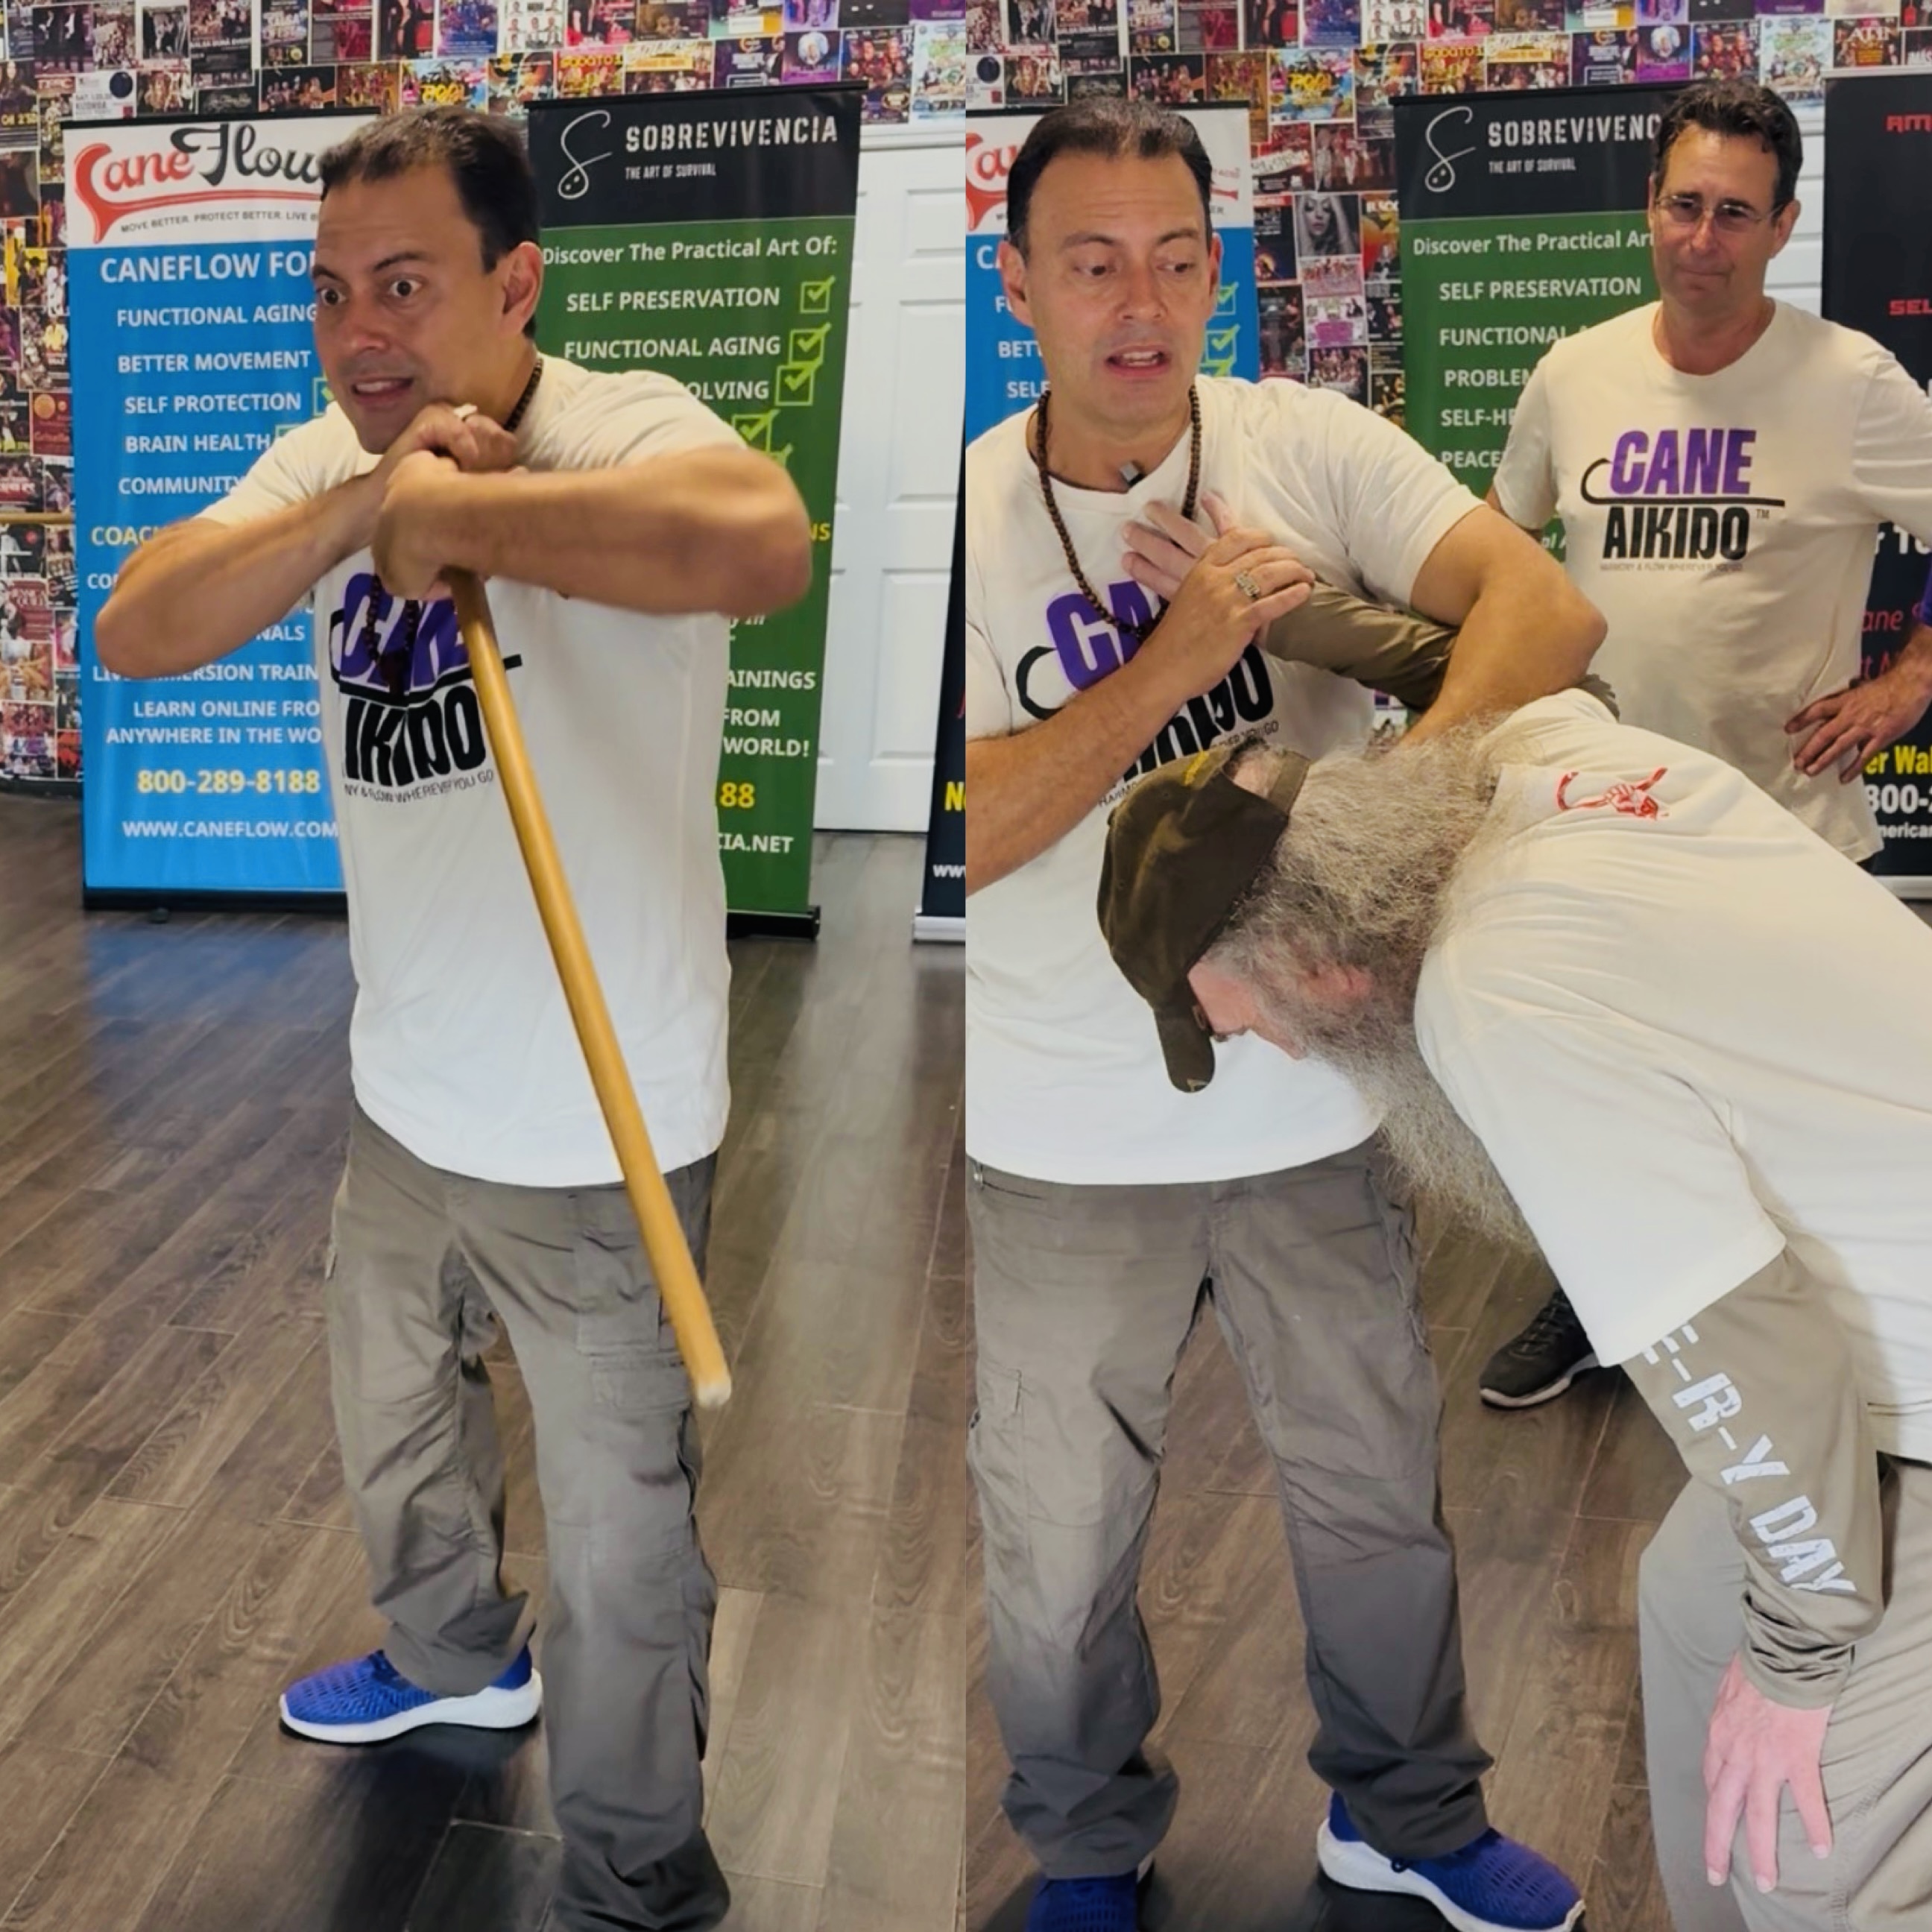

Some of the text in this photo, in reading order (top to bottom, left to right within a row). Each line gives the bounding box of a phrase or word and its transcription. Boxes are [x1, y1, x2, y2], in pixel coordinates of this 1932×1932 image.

[626, 116, 838, 152] SOBREVIVENCIA
[625, 162, 716, 180] THE ART OF SURVIVAL
[1489, 157, 1576, 174] THE ART OF SURVIVAL
[121, 221, 148, 233] MOVE
[194, 211, 239, 221] PROTECT
[286, 212, 306, 221] LIVE
[543, 236, 837, 265] Discover The Practical Art Of:
[1413, 239, 1491, 256] Discover
[1496, 235, 1531, 252] The
[1537, 231, 1620, 251] Practical
[101, 252, 260, 283] CANEFLOW
[566, 287, 780, 312] SELF PRESERVATION
[1439, 277, 1641, 300] SELF PRESERVATION
[117, 304, 316, 327] FUNCTIONAL AGING
[564, 335, 780, 359] FUNCTIONAL AGING
[118, 350, 312, 373] BETTER MOVEMENT
[684, 381, 768, 400] OLVING
[124, 393, 301, 414] SELF PROTECTION
[125, 433, 271, 453] BRAIN HEALTH
[1609, 429, 1756, 495] CANE
[1603, 506, 1750, 561] AIKIDO
[133, 701, 195, 717] LEARN
[201, 700, 277, 717] ONLINE
[106, 727, 212, 745] ANYWHERE
[218, 727, 241, 744] IN
[247, 727, 282, 744] THE
[723, 736, 809, 758] WORLD!
[137, 769, 320, 794] 800-289-8188
[477, 769, 494, 783] GO
[122, 821, 339, 839] WWW.CANEFLOW.COM
[1749, 1494, 1857, 1591] DAY
